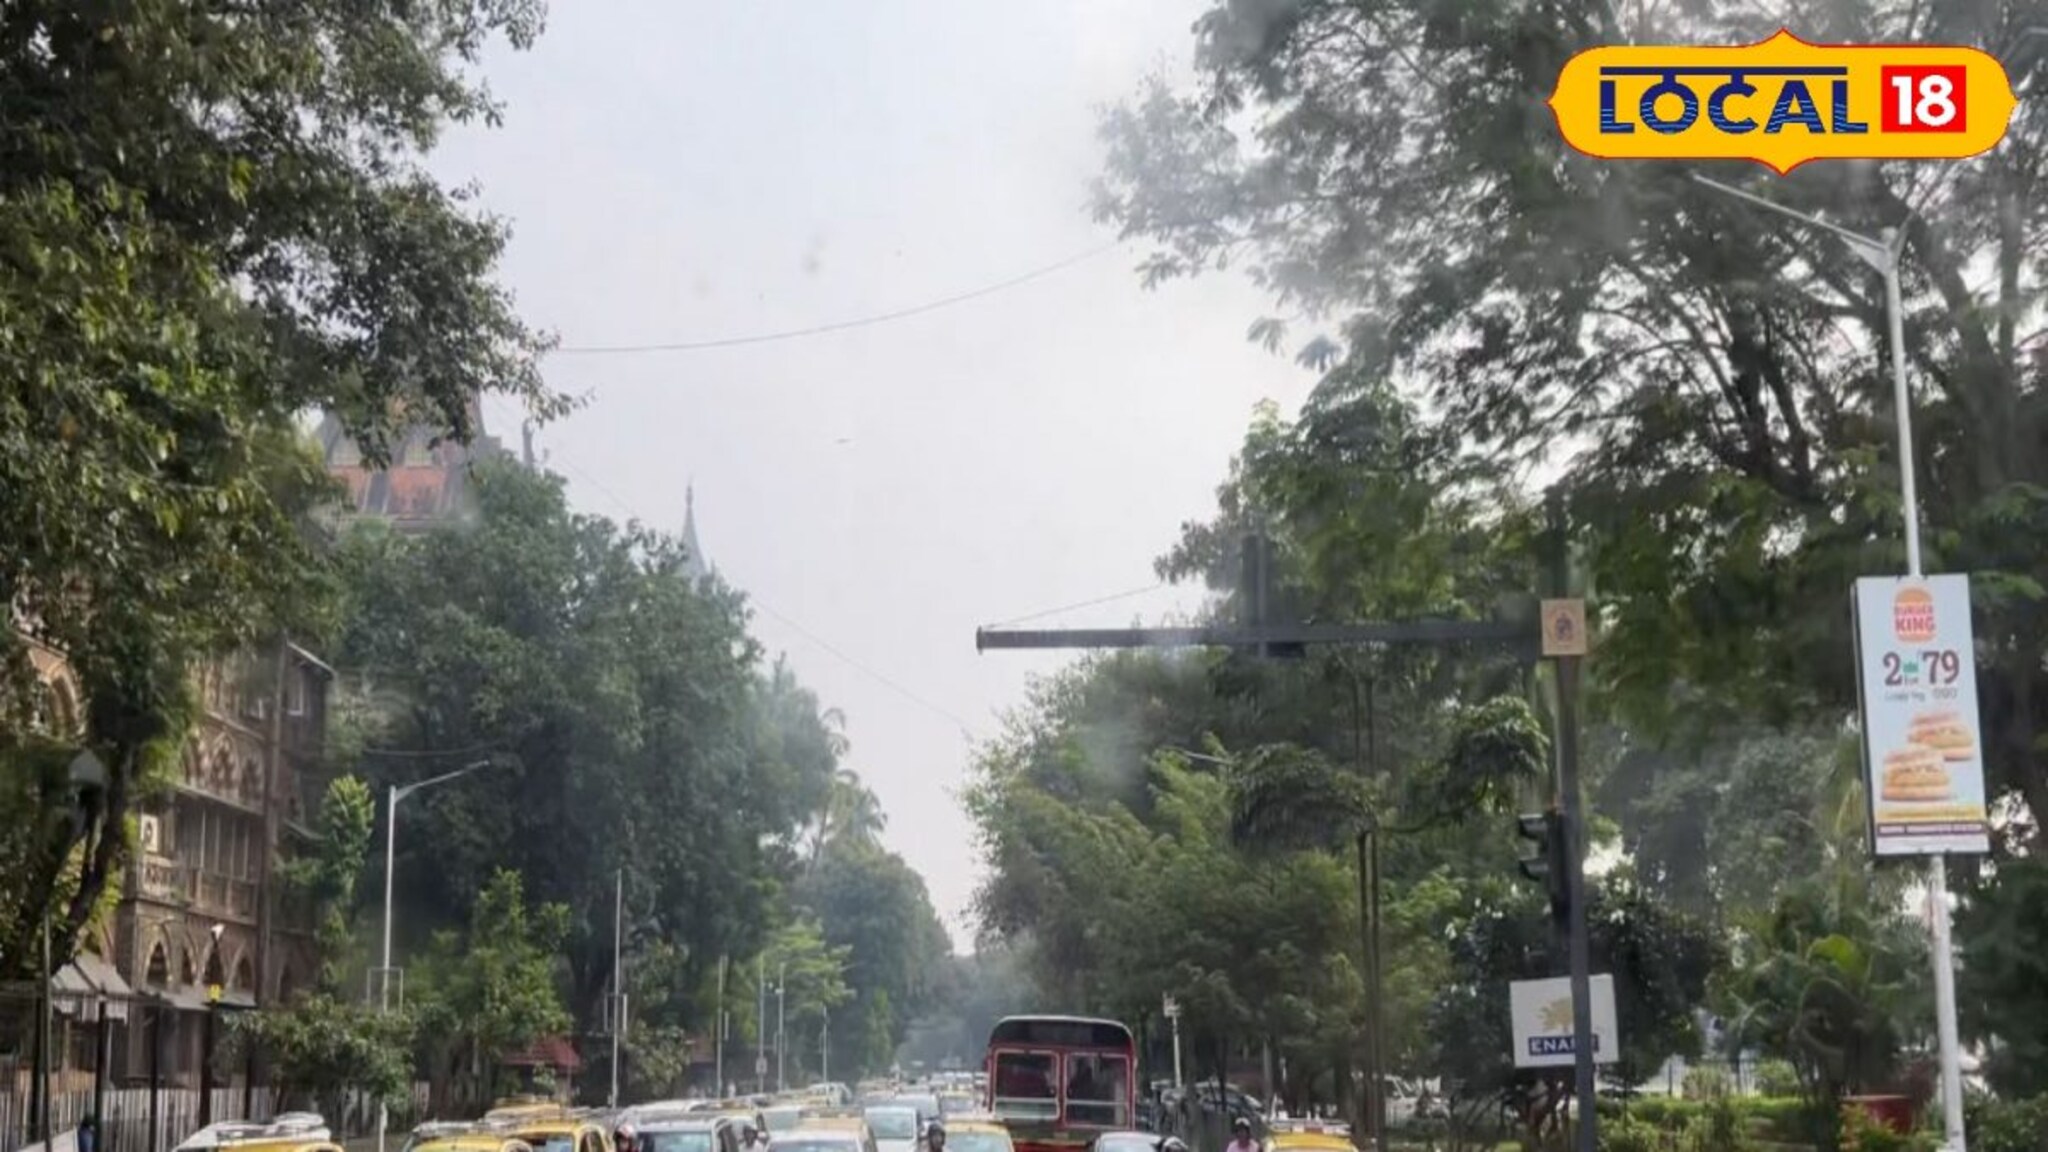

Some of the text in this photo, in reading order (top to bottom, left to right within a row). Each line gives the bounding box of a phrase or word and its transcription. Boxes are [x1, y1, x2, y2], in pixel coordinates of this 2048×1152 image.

[1894, 604, 1934, 615] BURGER
[1895, 616, 1936, 633] KING
[1882, 651, 1903, 687] 2
